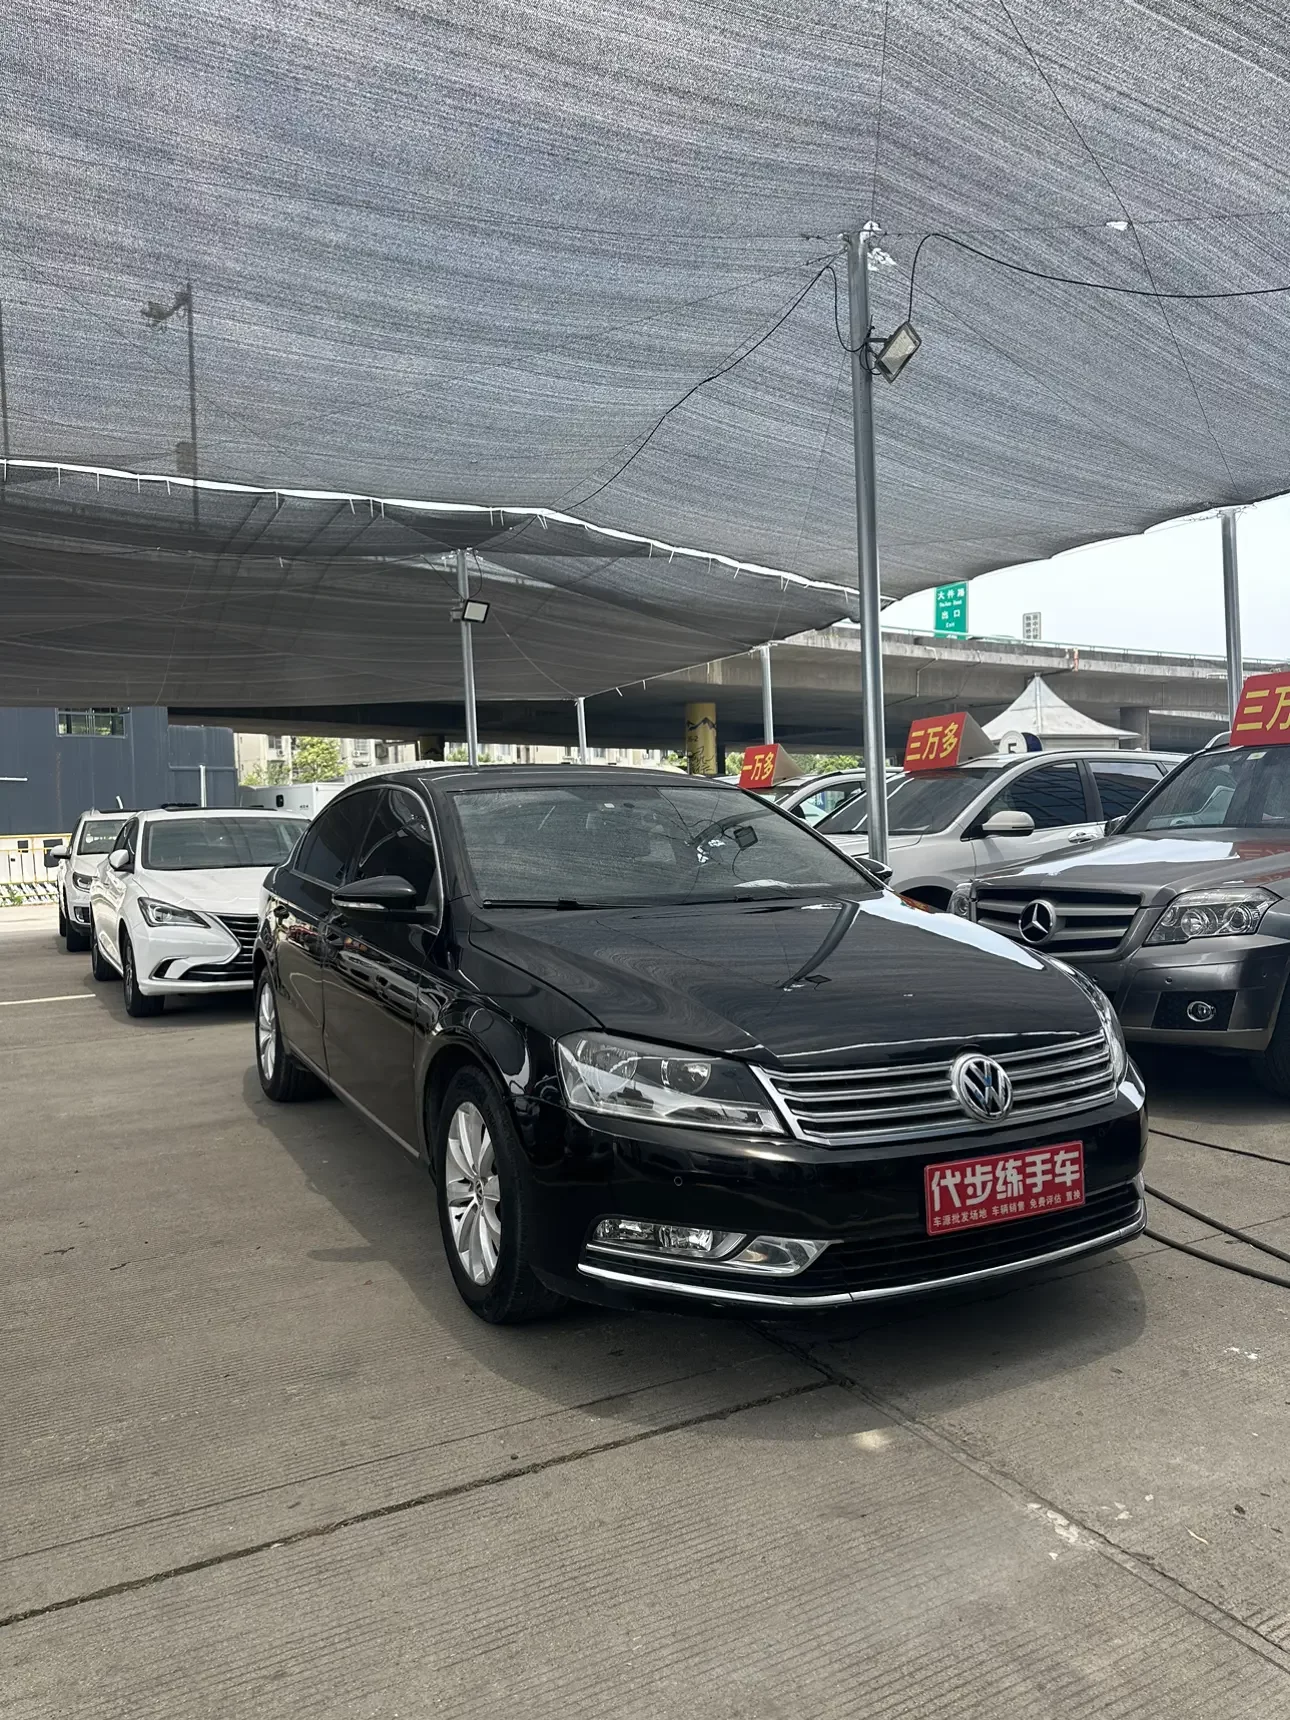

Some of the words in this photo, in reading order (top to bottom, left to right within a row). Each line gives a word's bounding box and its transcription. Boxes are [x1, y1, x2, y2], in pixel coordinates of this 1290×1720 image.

[941, 609, 961, 620] 出口
[906, 722, 959, 761] 三万多
[742, 751, 774, 780] 一万多
[931, 1150, 1081, 1212] 代步练手车
[933, 1209, 988, 1228] 车源批发场地
[992, 1200, 1025, 1217] 车辆销售
[1029, 1194, 1062, 1210] 免费评估
